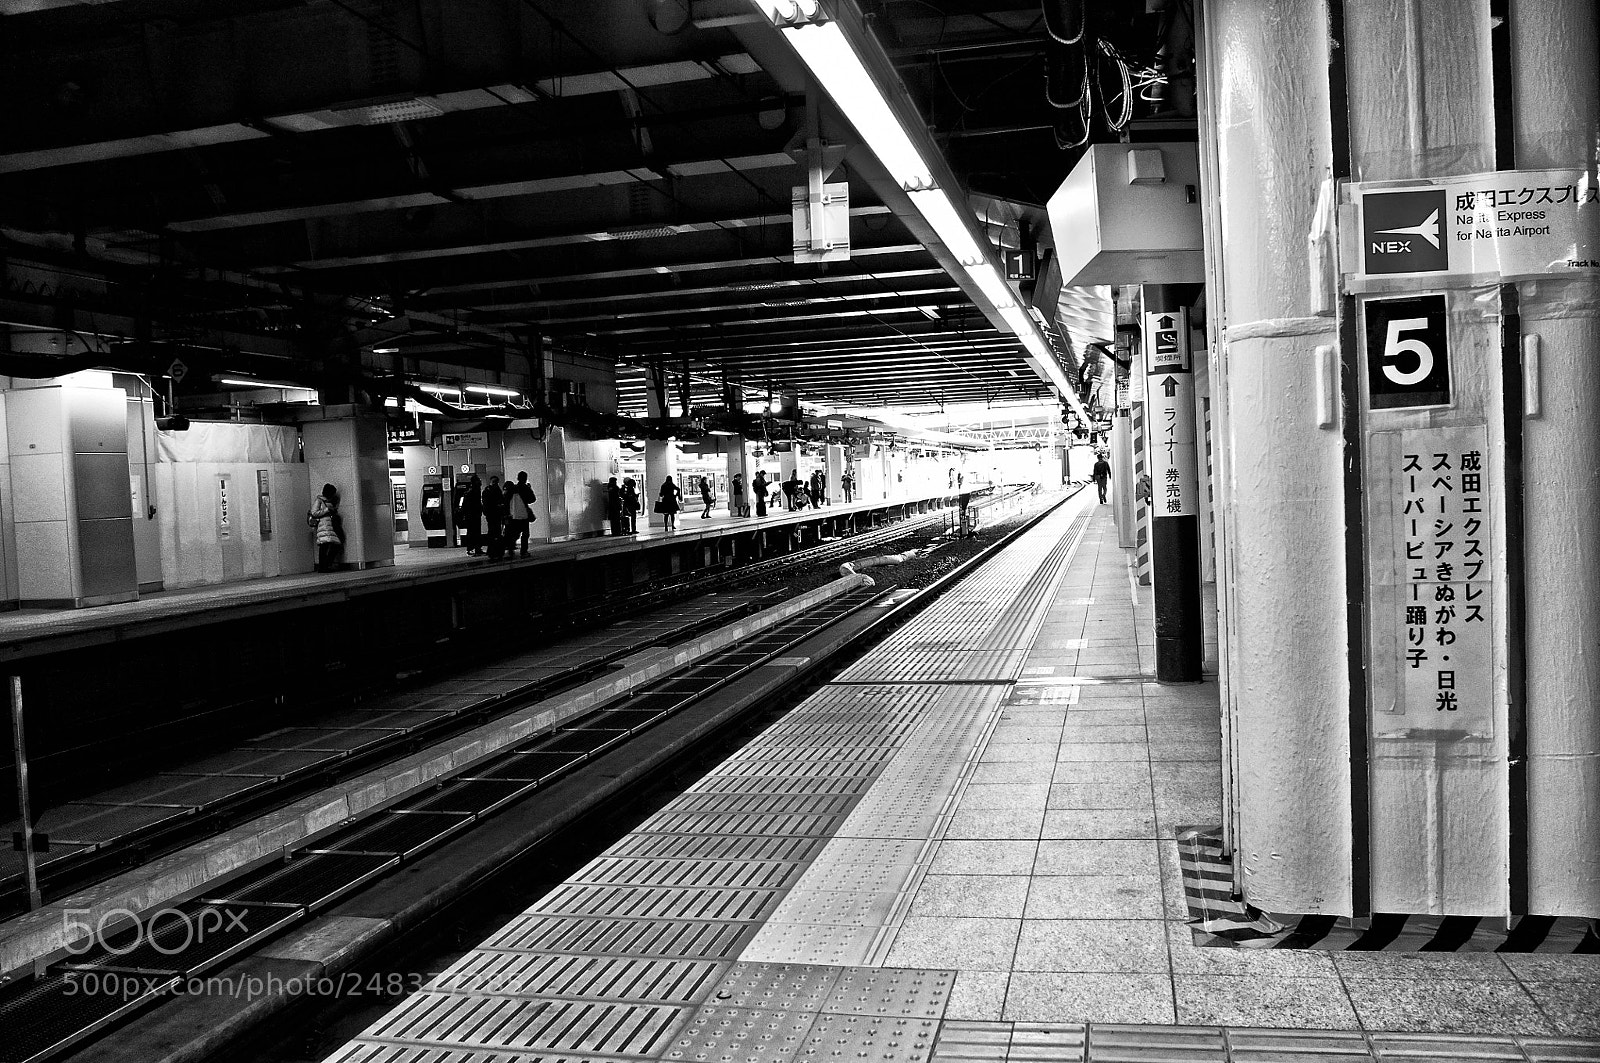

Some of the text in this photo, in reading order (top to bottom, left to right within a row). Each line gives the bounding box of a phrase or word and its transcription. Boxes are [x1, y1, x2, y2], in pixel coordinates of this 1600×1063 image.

[1457, 225, 1550, 241] for Naita Airport
[1498, 210, 1546, 222] Express
[1013, 254, 1023, 274] 1
[1567, 259, 1589, 268] Track
[1382, 317, 1434, 385] 5
[1164, 408, 1182, 513] ライナー券売機
[1402, 454, 1428, 668] スーパービュー踊り子
[1460, 451, 1485, 623] 成田エクスプレス
[1432, 453, 1458, 711] スペーシアきぬがわ・日光
